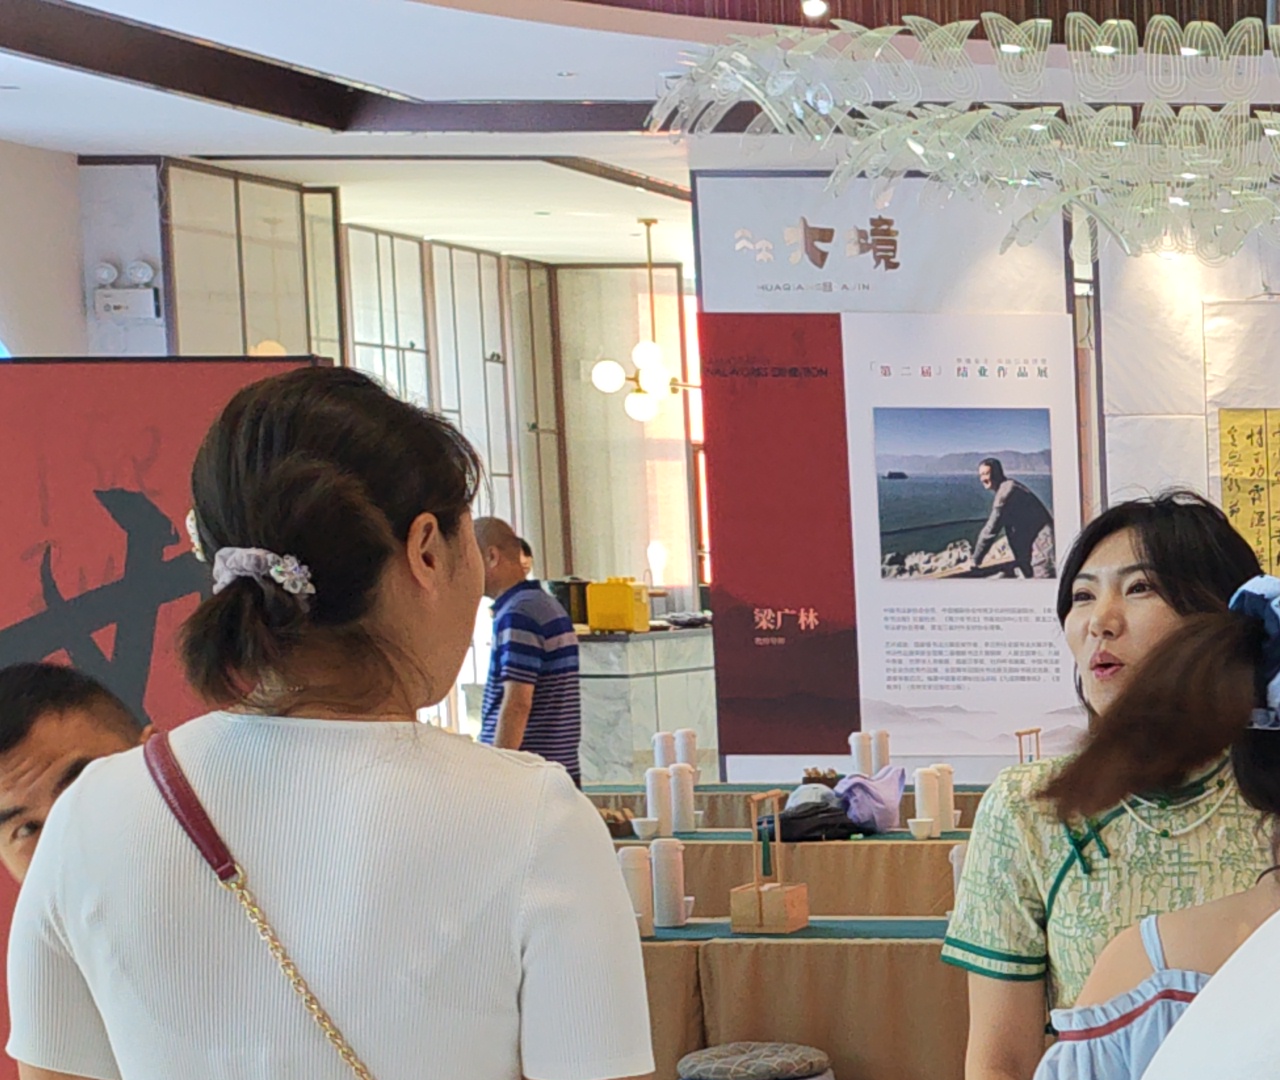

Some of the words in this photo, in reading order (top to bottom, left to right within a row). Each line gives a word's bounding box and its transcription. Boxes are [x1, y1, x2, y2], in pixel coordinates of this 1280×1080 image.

[784, 215, 901, 271] 大境
[754, 608, 819, 630] 梁广林
